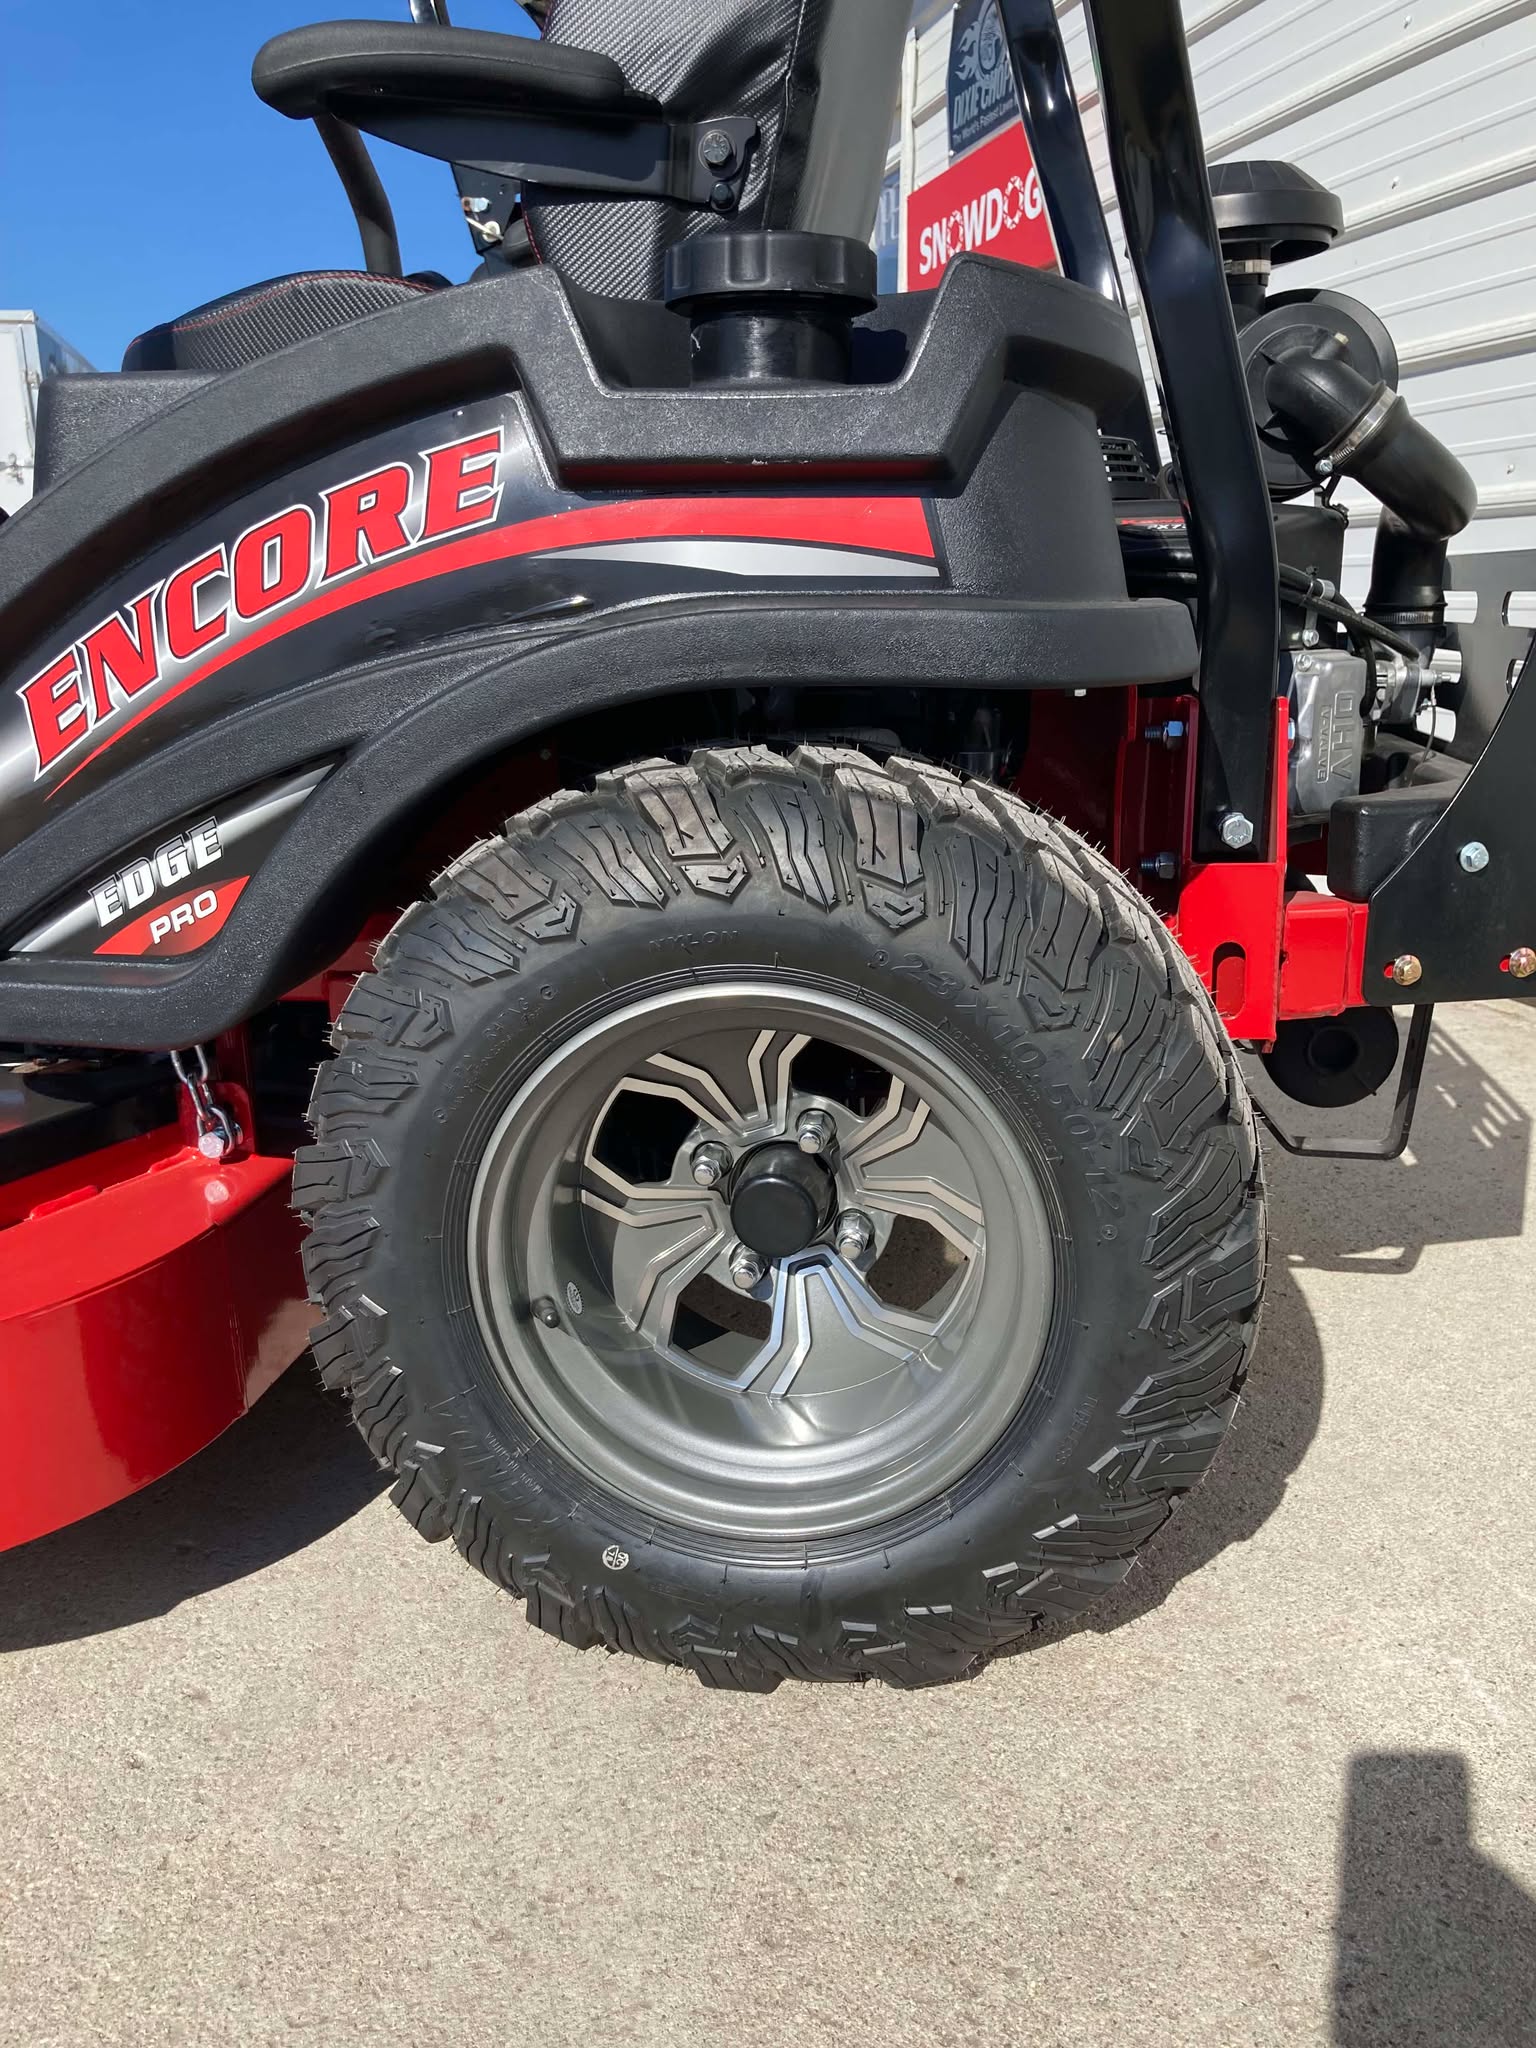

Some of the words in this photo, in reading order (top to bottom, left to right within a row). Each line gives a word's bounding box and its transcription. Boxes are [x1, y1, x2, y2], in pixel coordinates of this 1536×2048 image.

[919, 167, 1043, 275] SNOWDOG
[16, 425, 504, 781] ENCORE
[1331, 690, 1354, 780] OHV
[89, 816, 223, 927] EDGE
[151, 890, 219, 944] PRO
